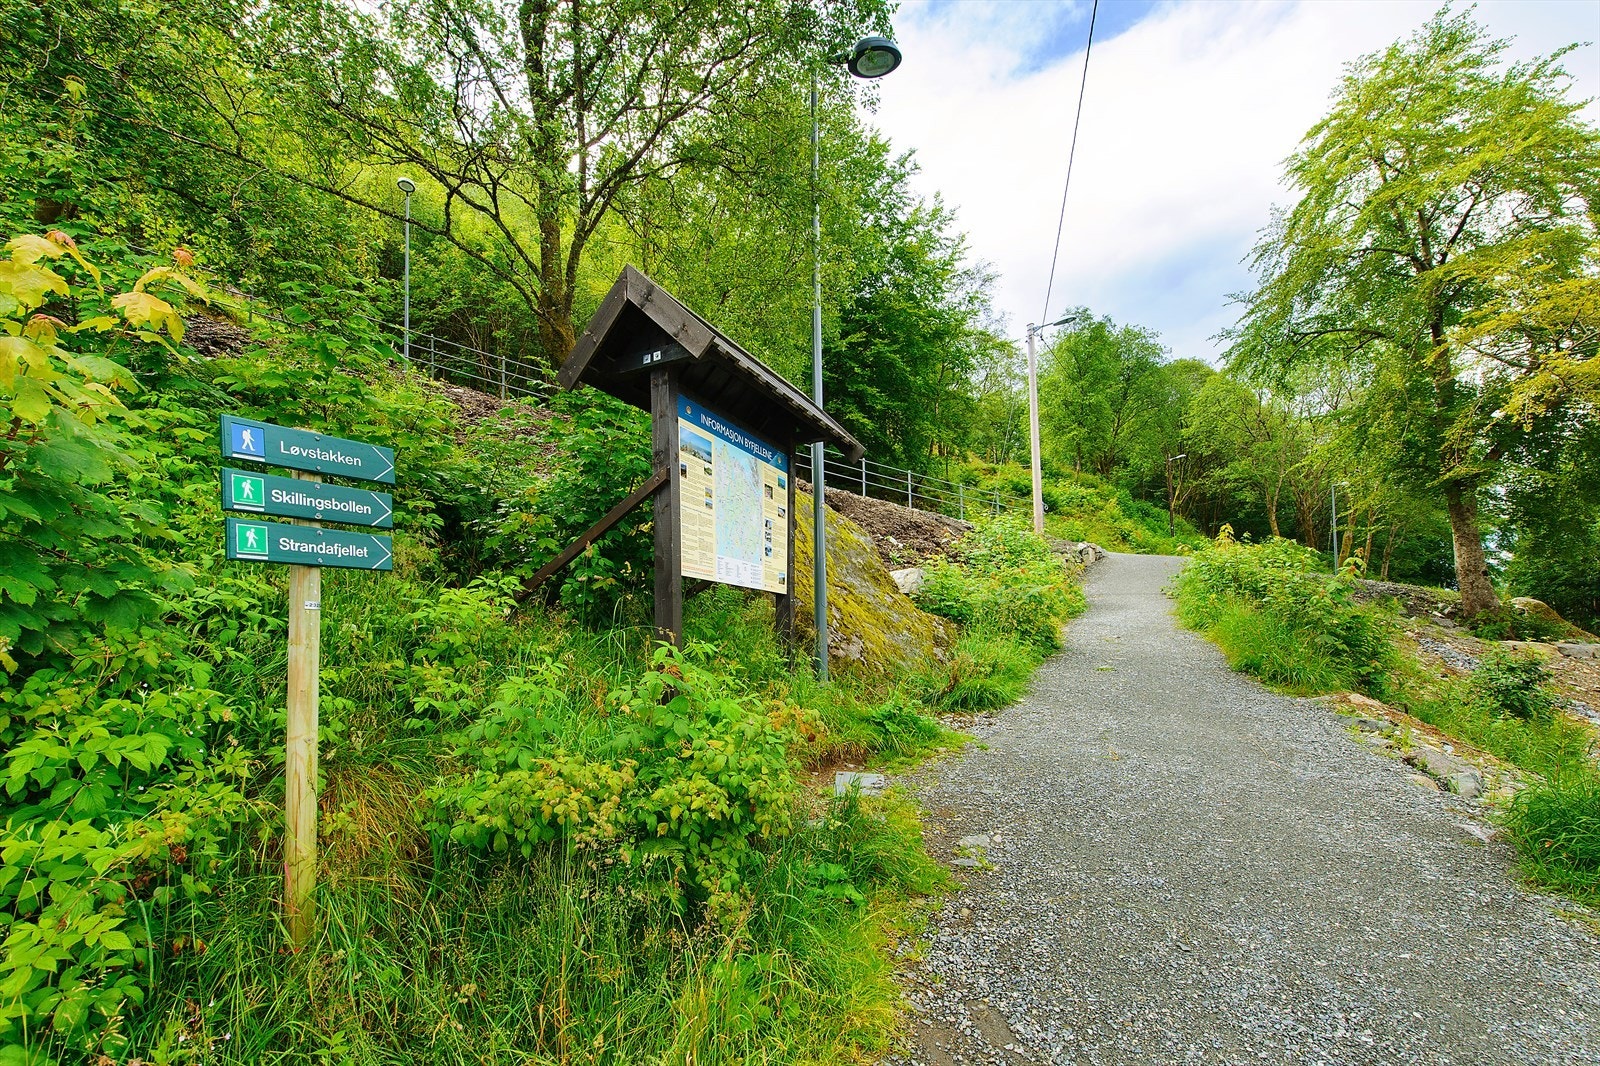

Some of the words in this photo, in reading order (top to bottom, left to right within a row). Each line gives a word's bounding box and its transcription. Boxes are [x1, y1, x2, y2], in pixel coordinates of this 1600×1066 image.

[701, 413, 744, 445] INFORMASJON
[744, 437, 772, 460] BYFJELLENE
[281, 441, 362, 466] Løvstakken
[271, 489, 372, 514] Skillingsbollen
[279, 537, 369, 558] Strandafjellet
